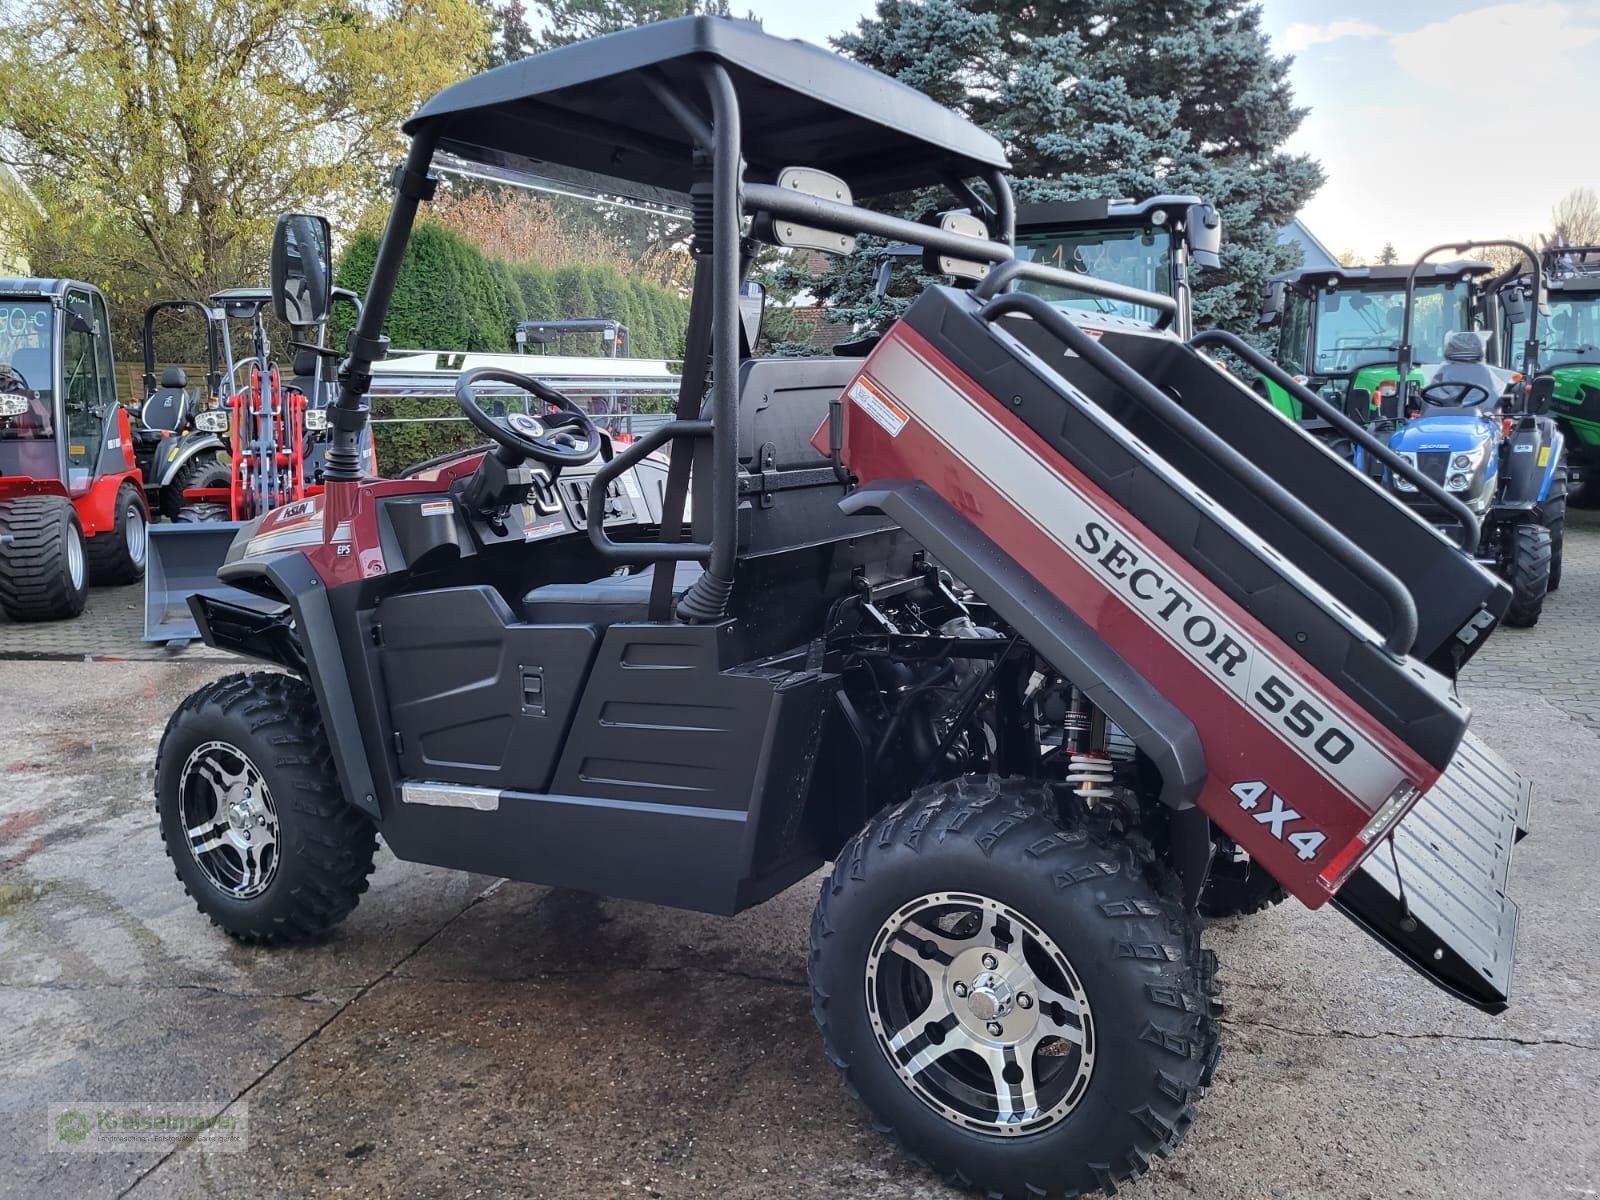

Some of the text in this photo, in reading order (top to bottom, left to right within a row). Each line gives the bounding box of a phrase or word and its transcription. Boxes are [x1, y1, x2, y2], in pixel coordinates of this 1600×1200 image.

[336, 544, 351, 555] EPS
[1075, 522, 1355, 764] SECTOR 550
[1230, 779, 1328, 861] 4X4
